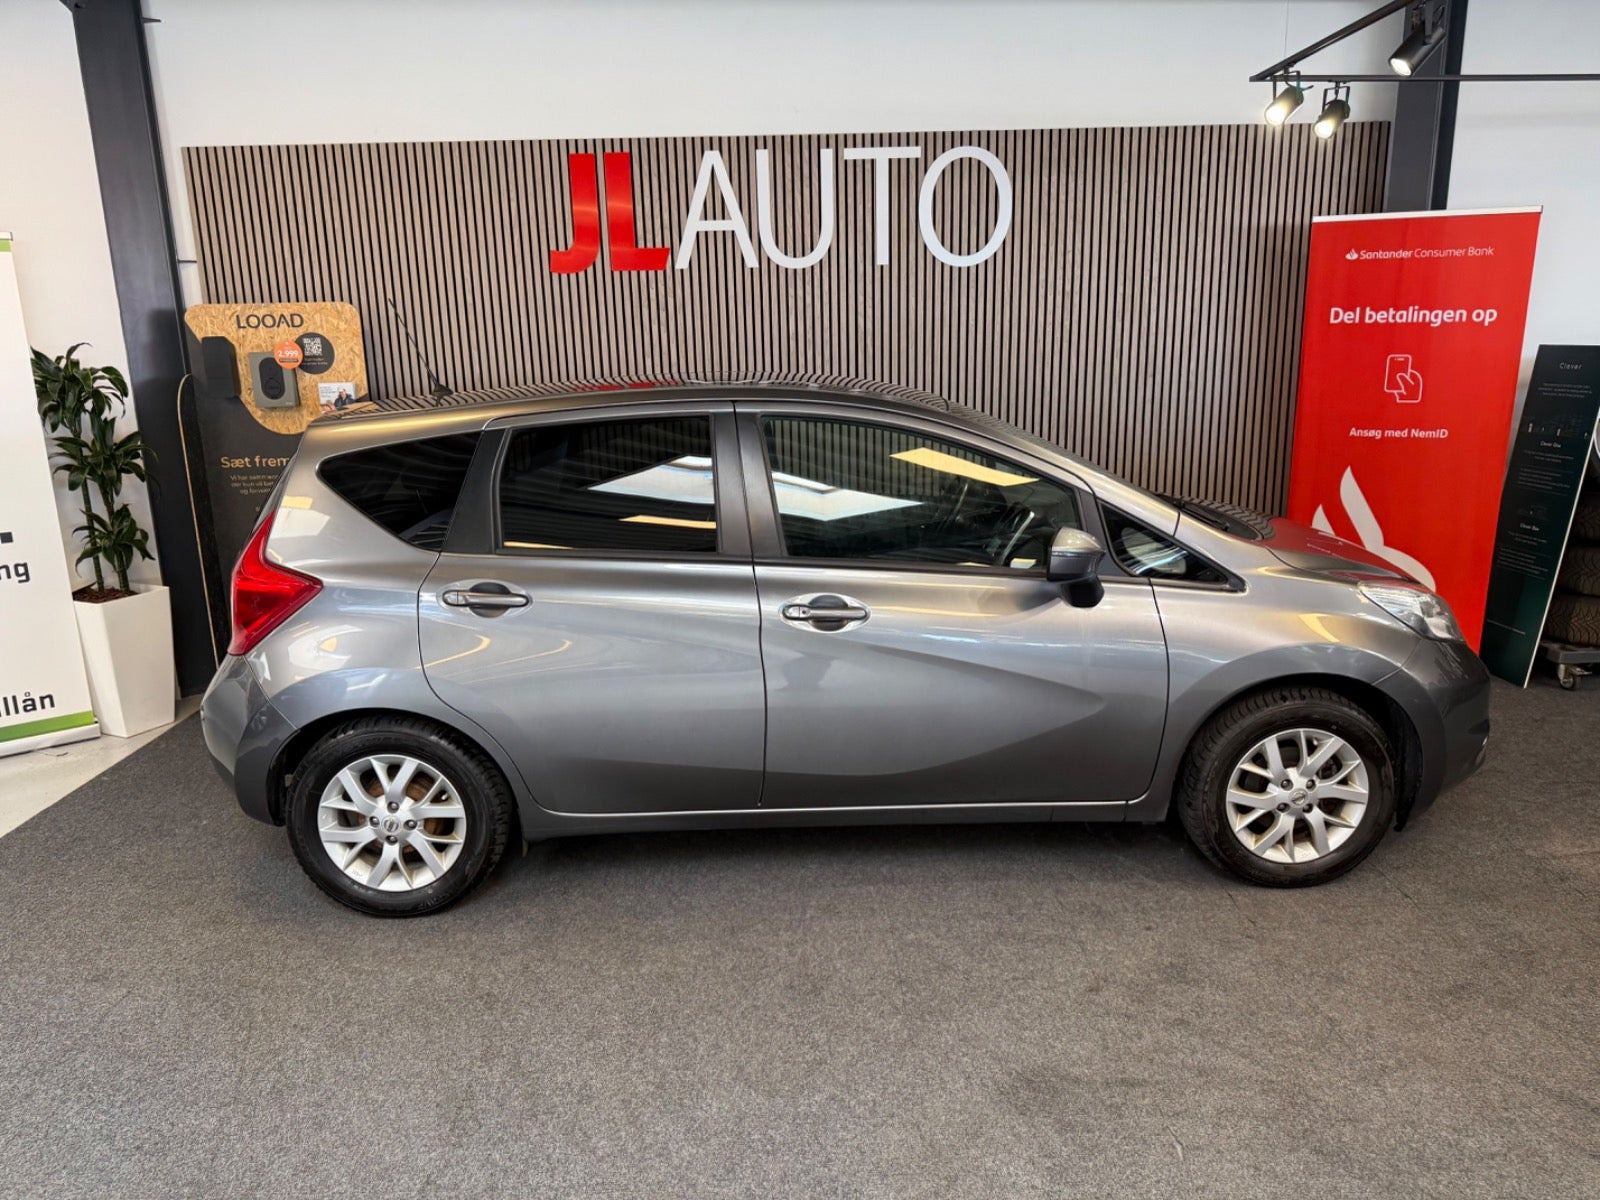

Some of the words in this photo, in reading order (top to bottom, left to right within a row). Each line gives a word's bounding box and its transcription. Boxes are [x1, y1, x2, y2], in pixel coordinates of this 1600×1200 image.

[1360, 249, 1414, 260] Santander
[1414, 247, 1466, 258] Consumer
[1467, 246, 1494, 256] Bank
[236, 313, 304, 329] LOOAD
[1330, 307, 1360, 324] Del
[1364, 306, 1466, 327] betalingen
[1472, 308, 1498, 326] op
[1560, 362, 1582, 370] Clever
[1349, 427, 1382, 439] Ansøg
[1384, 428, 1408, 438] med
[1410, 428, 1449, 439] NemID
[221, 456, 252, 468] Sæt
[0, 692, 56, 718] llån
